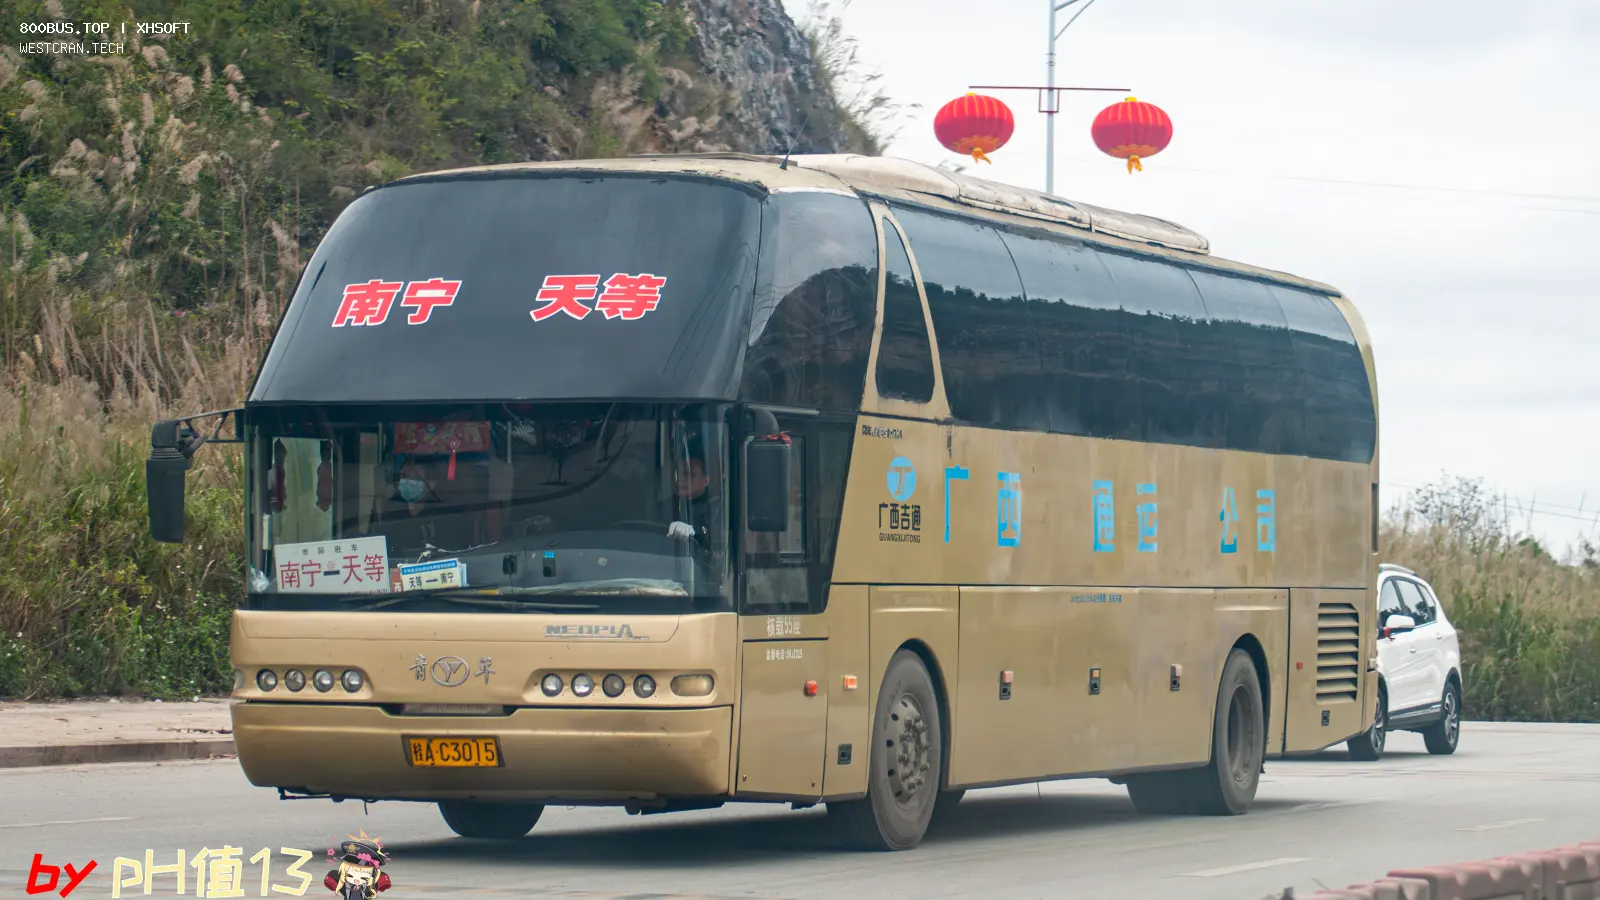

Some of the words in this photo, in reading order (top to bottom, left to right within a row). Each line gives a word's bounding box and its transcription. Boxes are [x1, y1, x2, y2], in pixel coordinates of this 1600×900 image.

[331, 278, 462, 328] 南宁
[530, 273, 667, 322] 天等
[878, 502, 921, 531] 广西吉通
